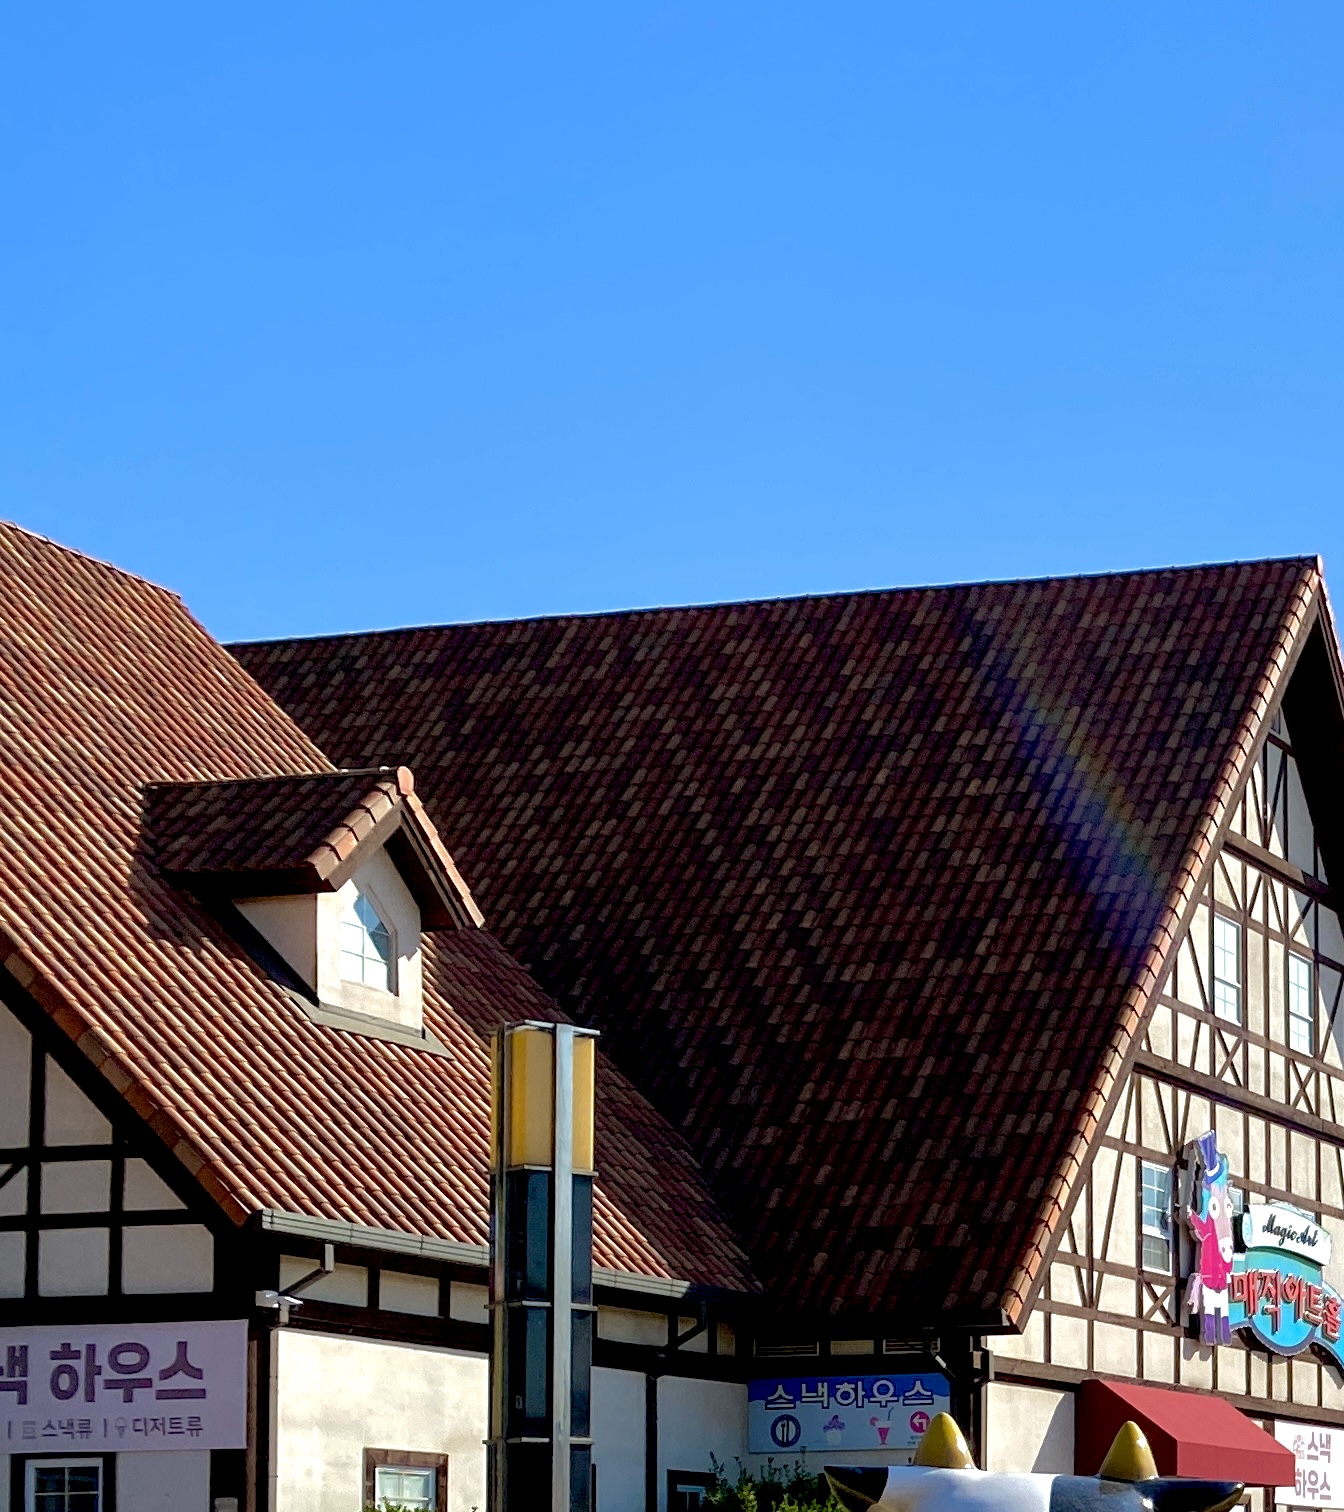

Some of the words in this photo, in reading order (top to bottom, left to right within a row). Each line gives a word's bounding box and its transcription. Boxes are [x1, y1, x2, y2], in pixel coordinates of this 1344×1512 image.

[1262, 1213, 1296, 1246] Magic
[1296, 1225, 1318, 1247] Art
[1231, 1269, 1342, 1342] 매직아트홀
[50, 1341, 206, 1403] 하우스
[765, 1379, 935, 1410] 스낵하우스
[41, 1418, 93, 1440] 스낵류
[132, 1416, 203, 1439] 디저트류
[1307, 1432, 1331, 1463] 스낵
[1295, 1468, 1331, 1500] 하우스
